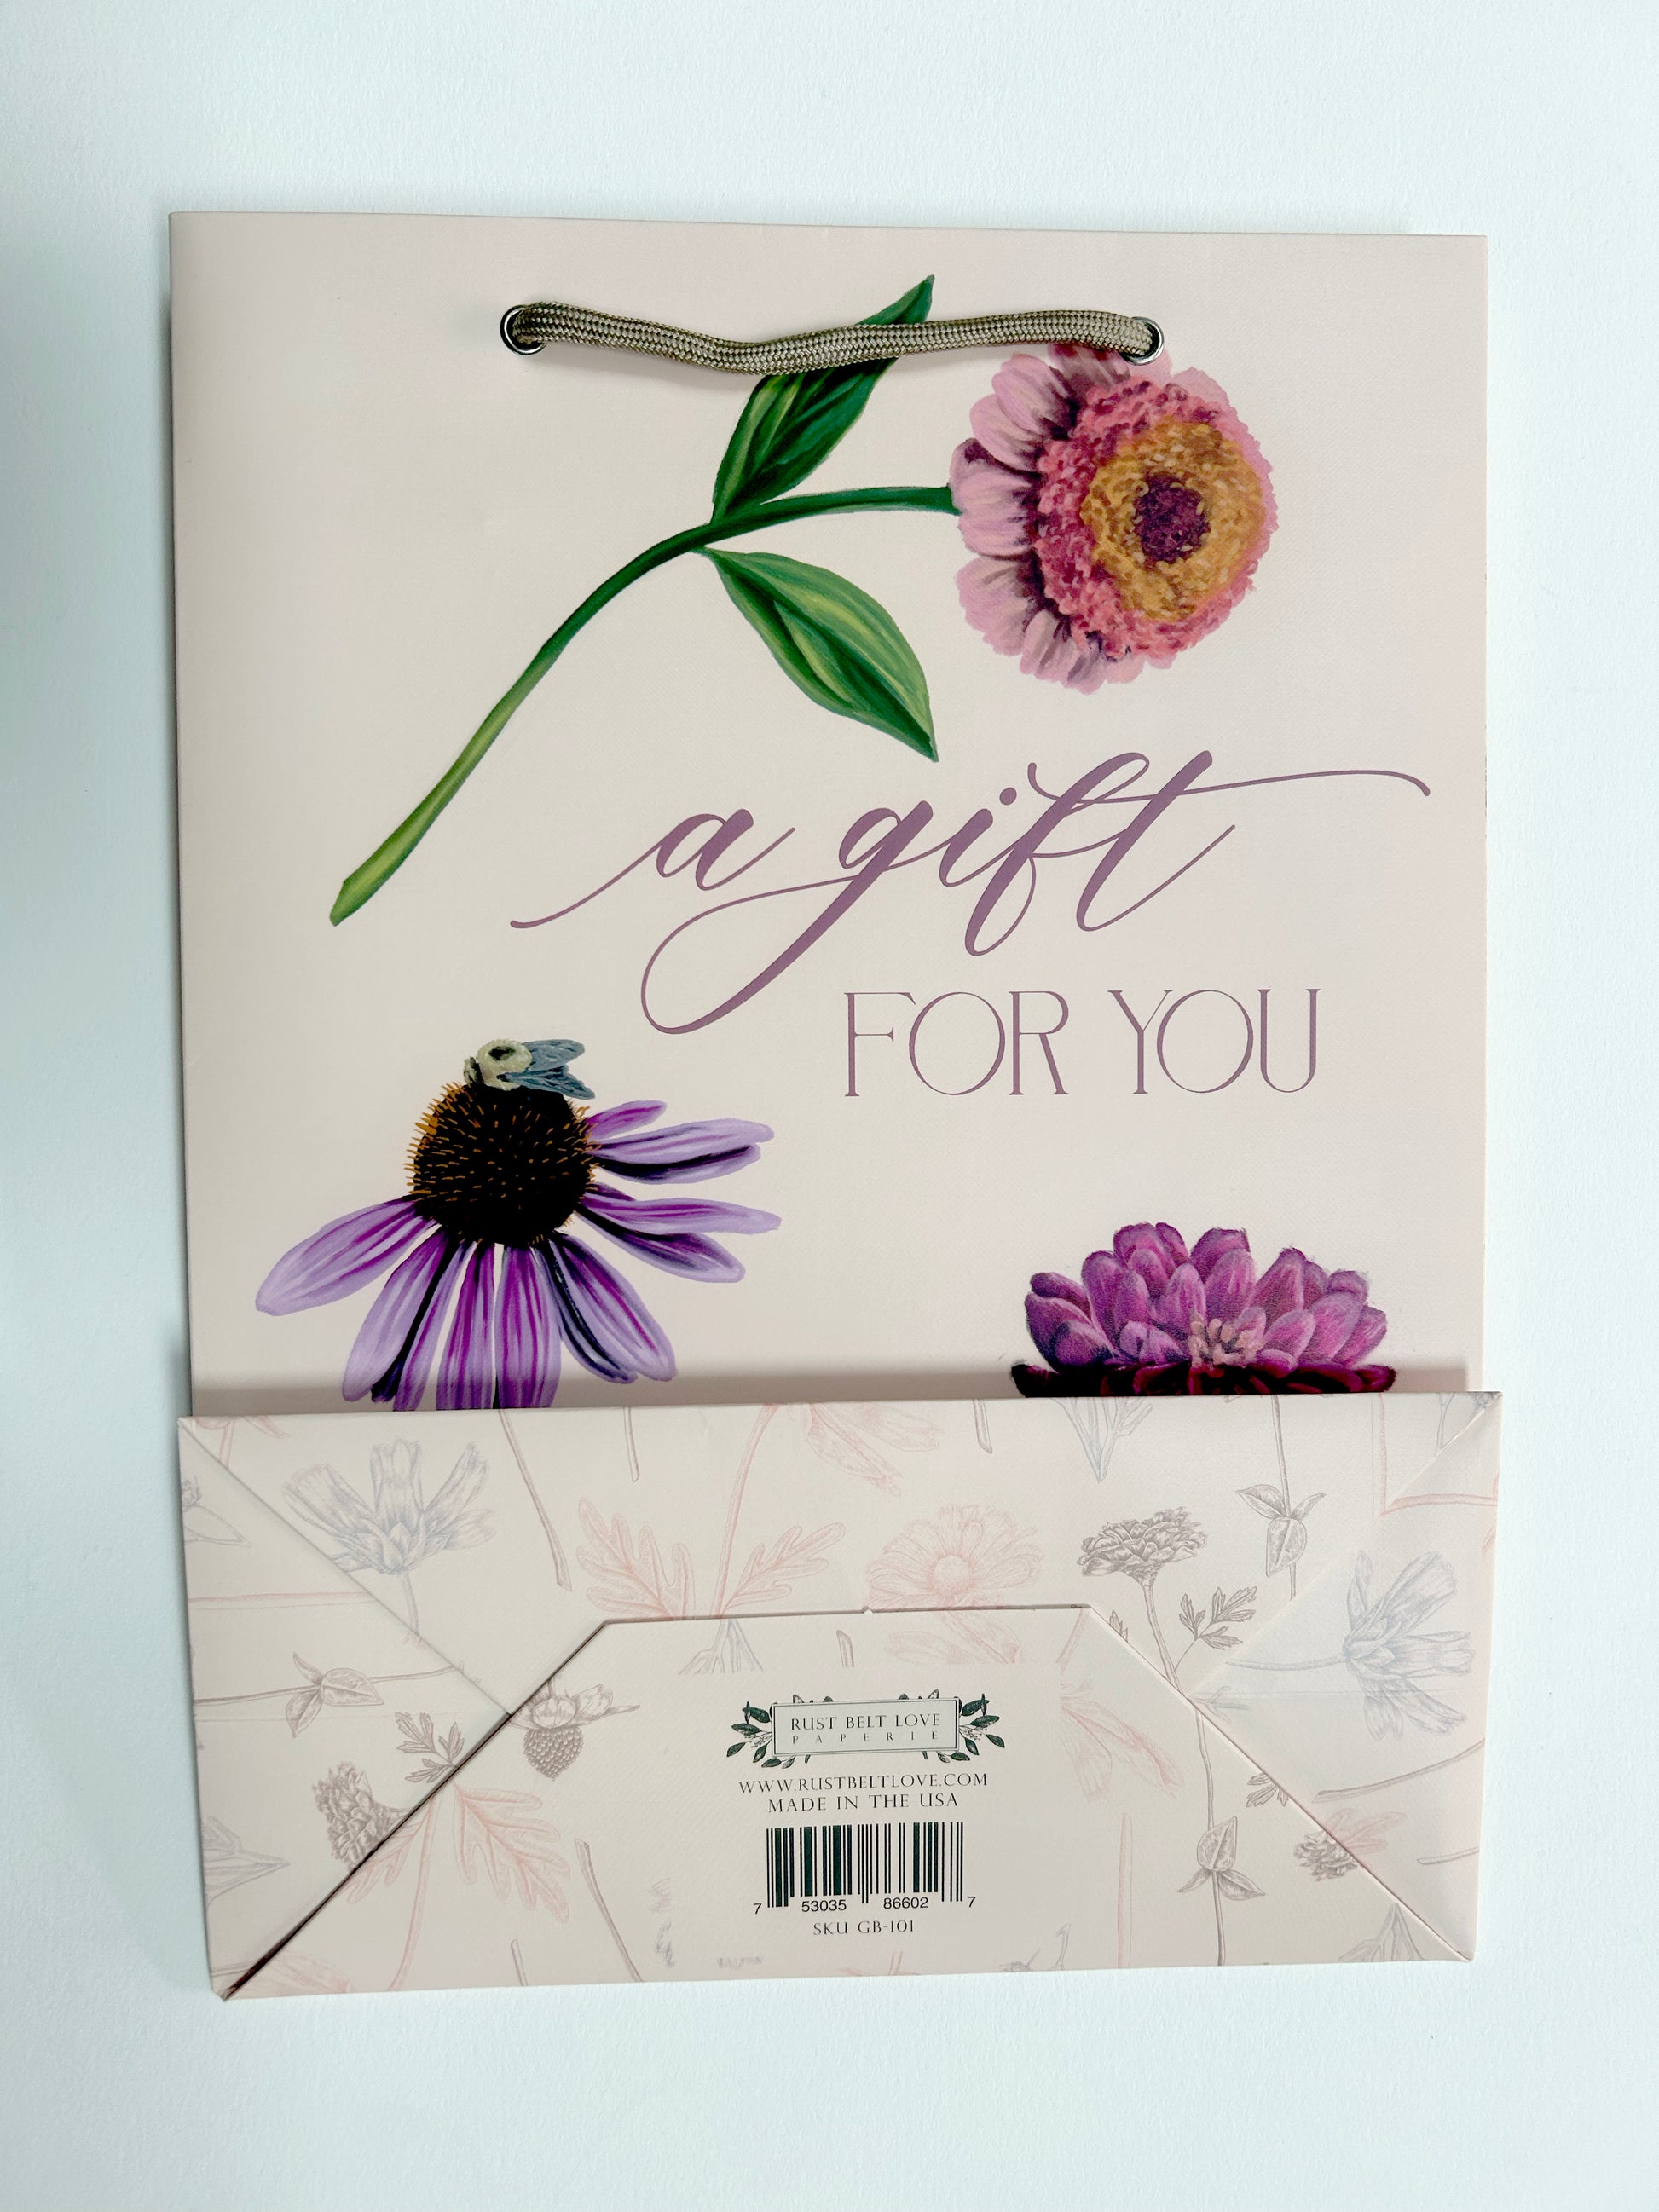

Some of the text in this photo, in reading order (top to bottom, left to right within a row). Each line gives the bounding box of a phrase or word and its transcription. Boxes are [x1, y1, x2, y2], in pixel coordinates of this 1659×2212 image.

[510, 750, 1431, 1035] a gift
[843, 988, 1321, 1097] FOR YOU
[791, 1713, 941, 1730] RUST BELT LOVE
[792, 1730, 939, 1745] PAPERIE
[738, 1773, 989, 1793] WWW.RUSTBELTLOVE.COM
[768, 1793, 958, 1813] MADE IN THE USA
[753, 1896, 977, 1915] 7 53035 86602 7
[813, 1920, 914, 1936] SKU GB-101
